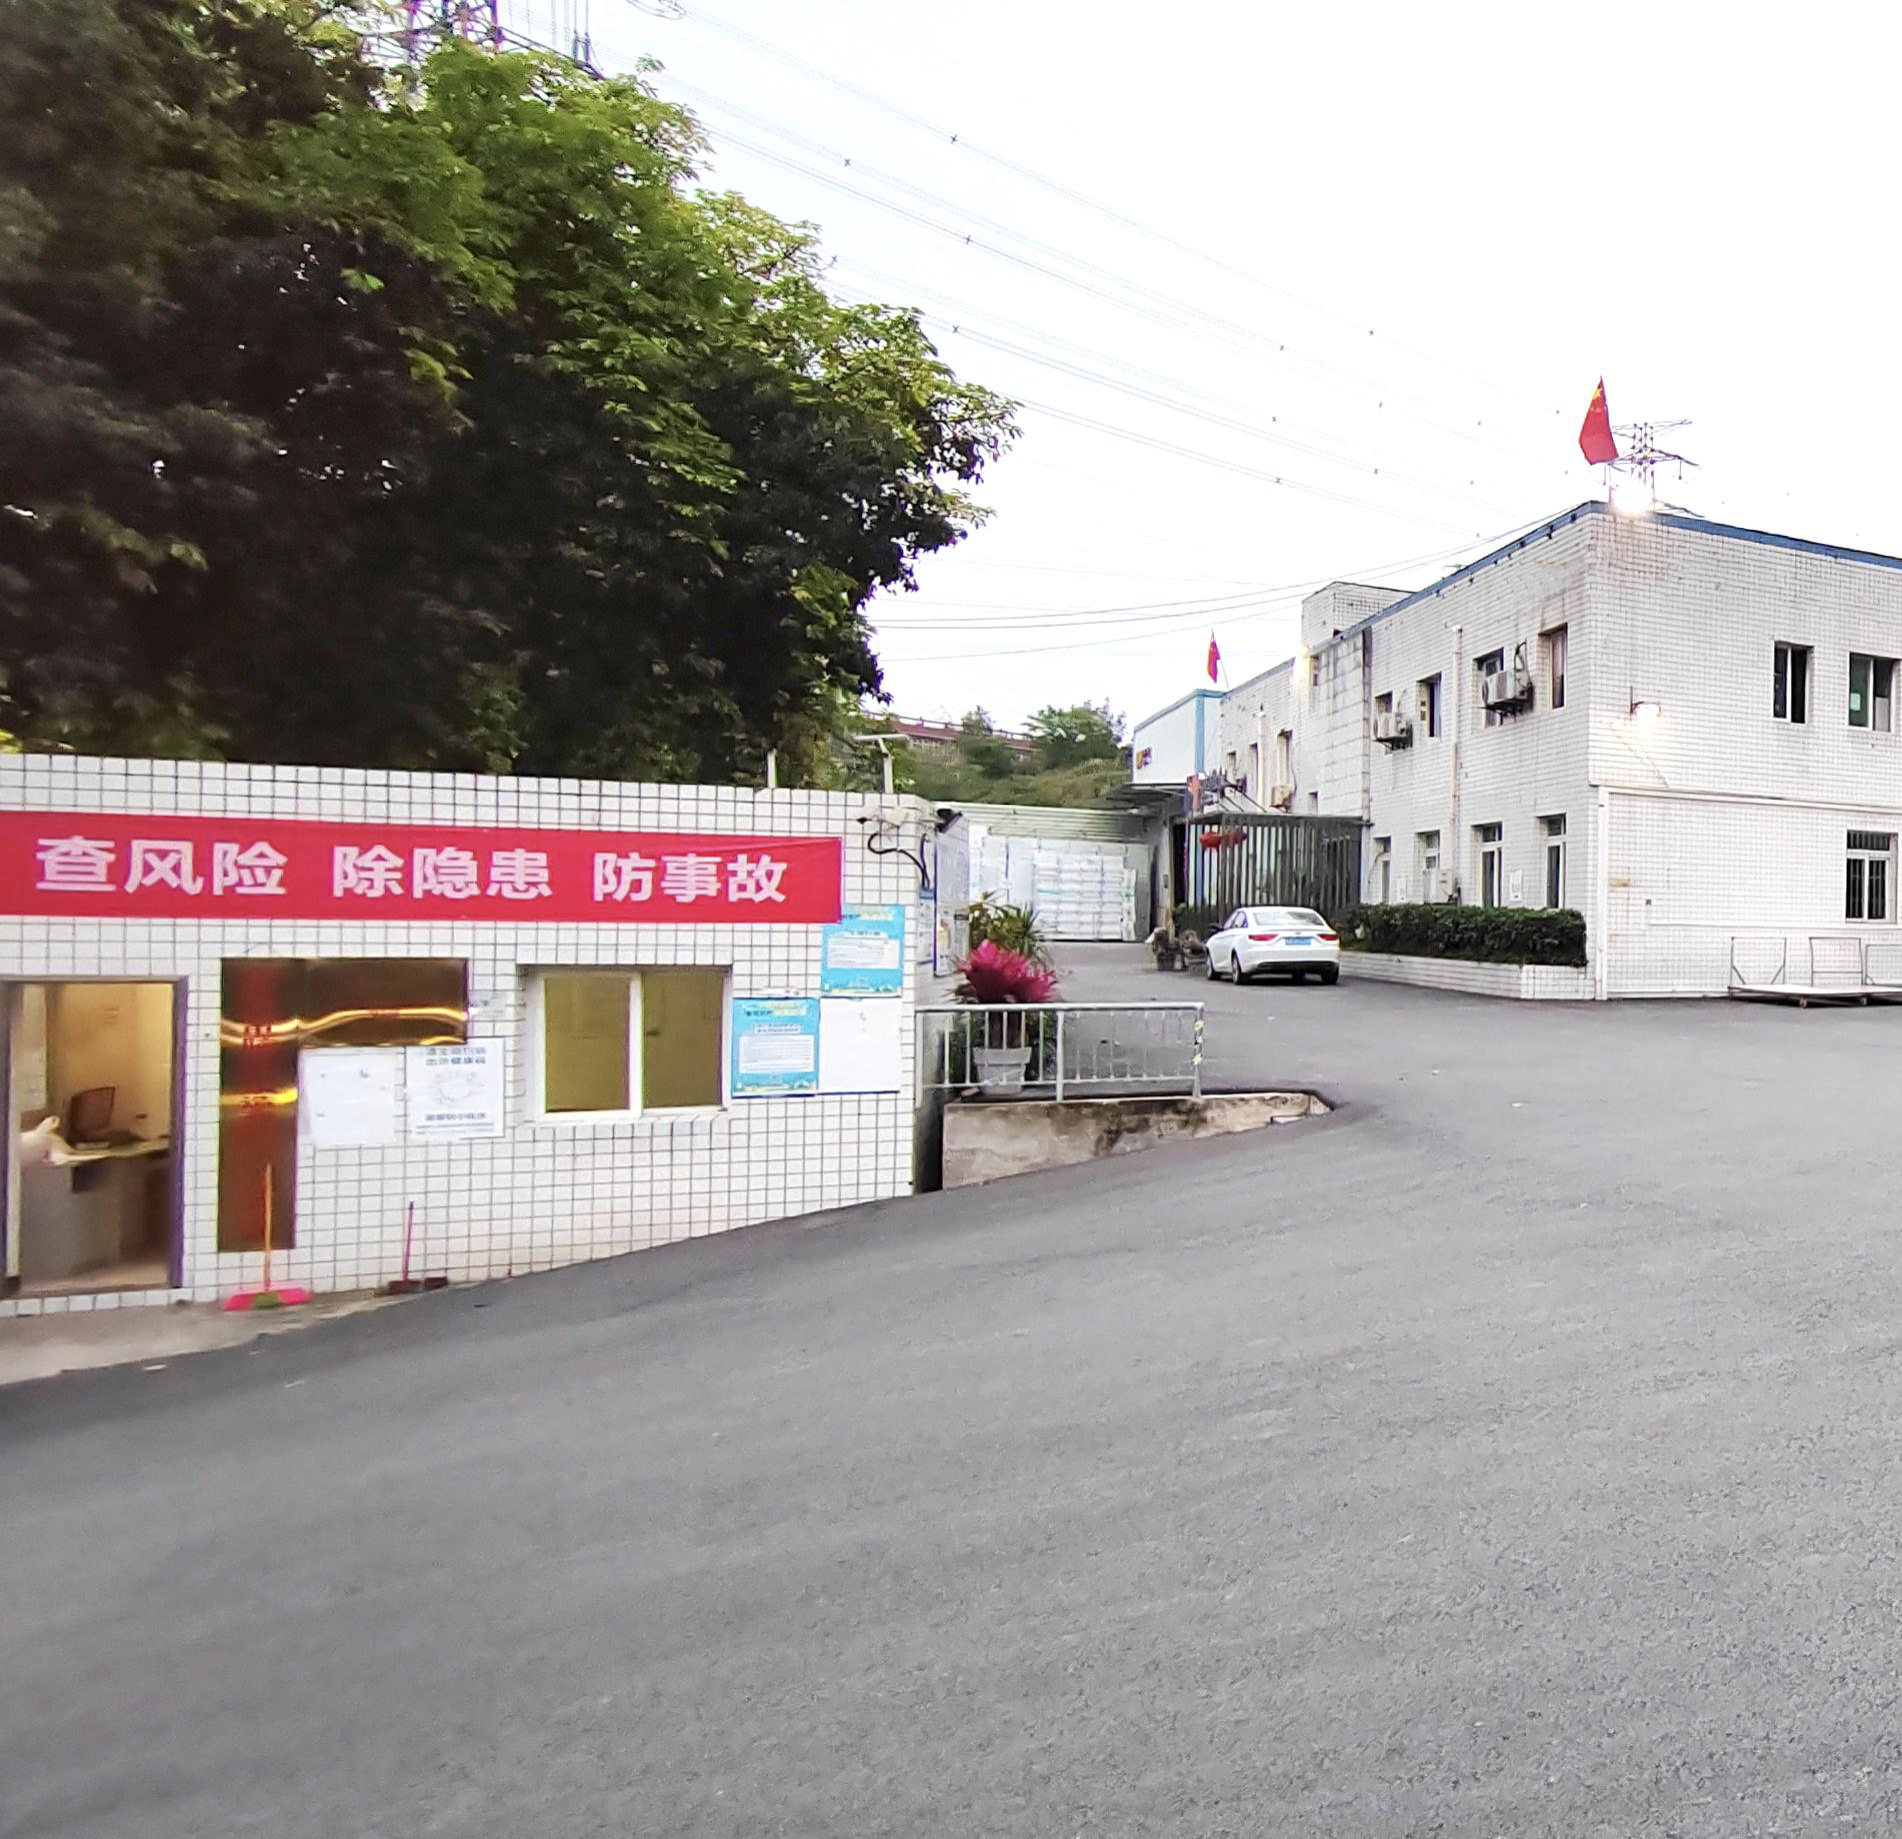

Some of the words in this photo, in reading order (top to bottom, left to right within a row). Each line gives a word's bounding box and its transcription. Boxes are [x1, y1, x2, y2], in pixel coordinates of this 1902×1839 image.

[36, 834, 289, 896] 查风险
[333, 845, 553, 899] 除隐患
[593, 851, 788, 904] 防事故
